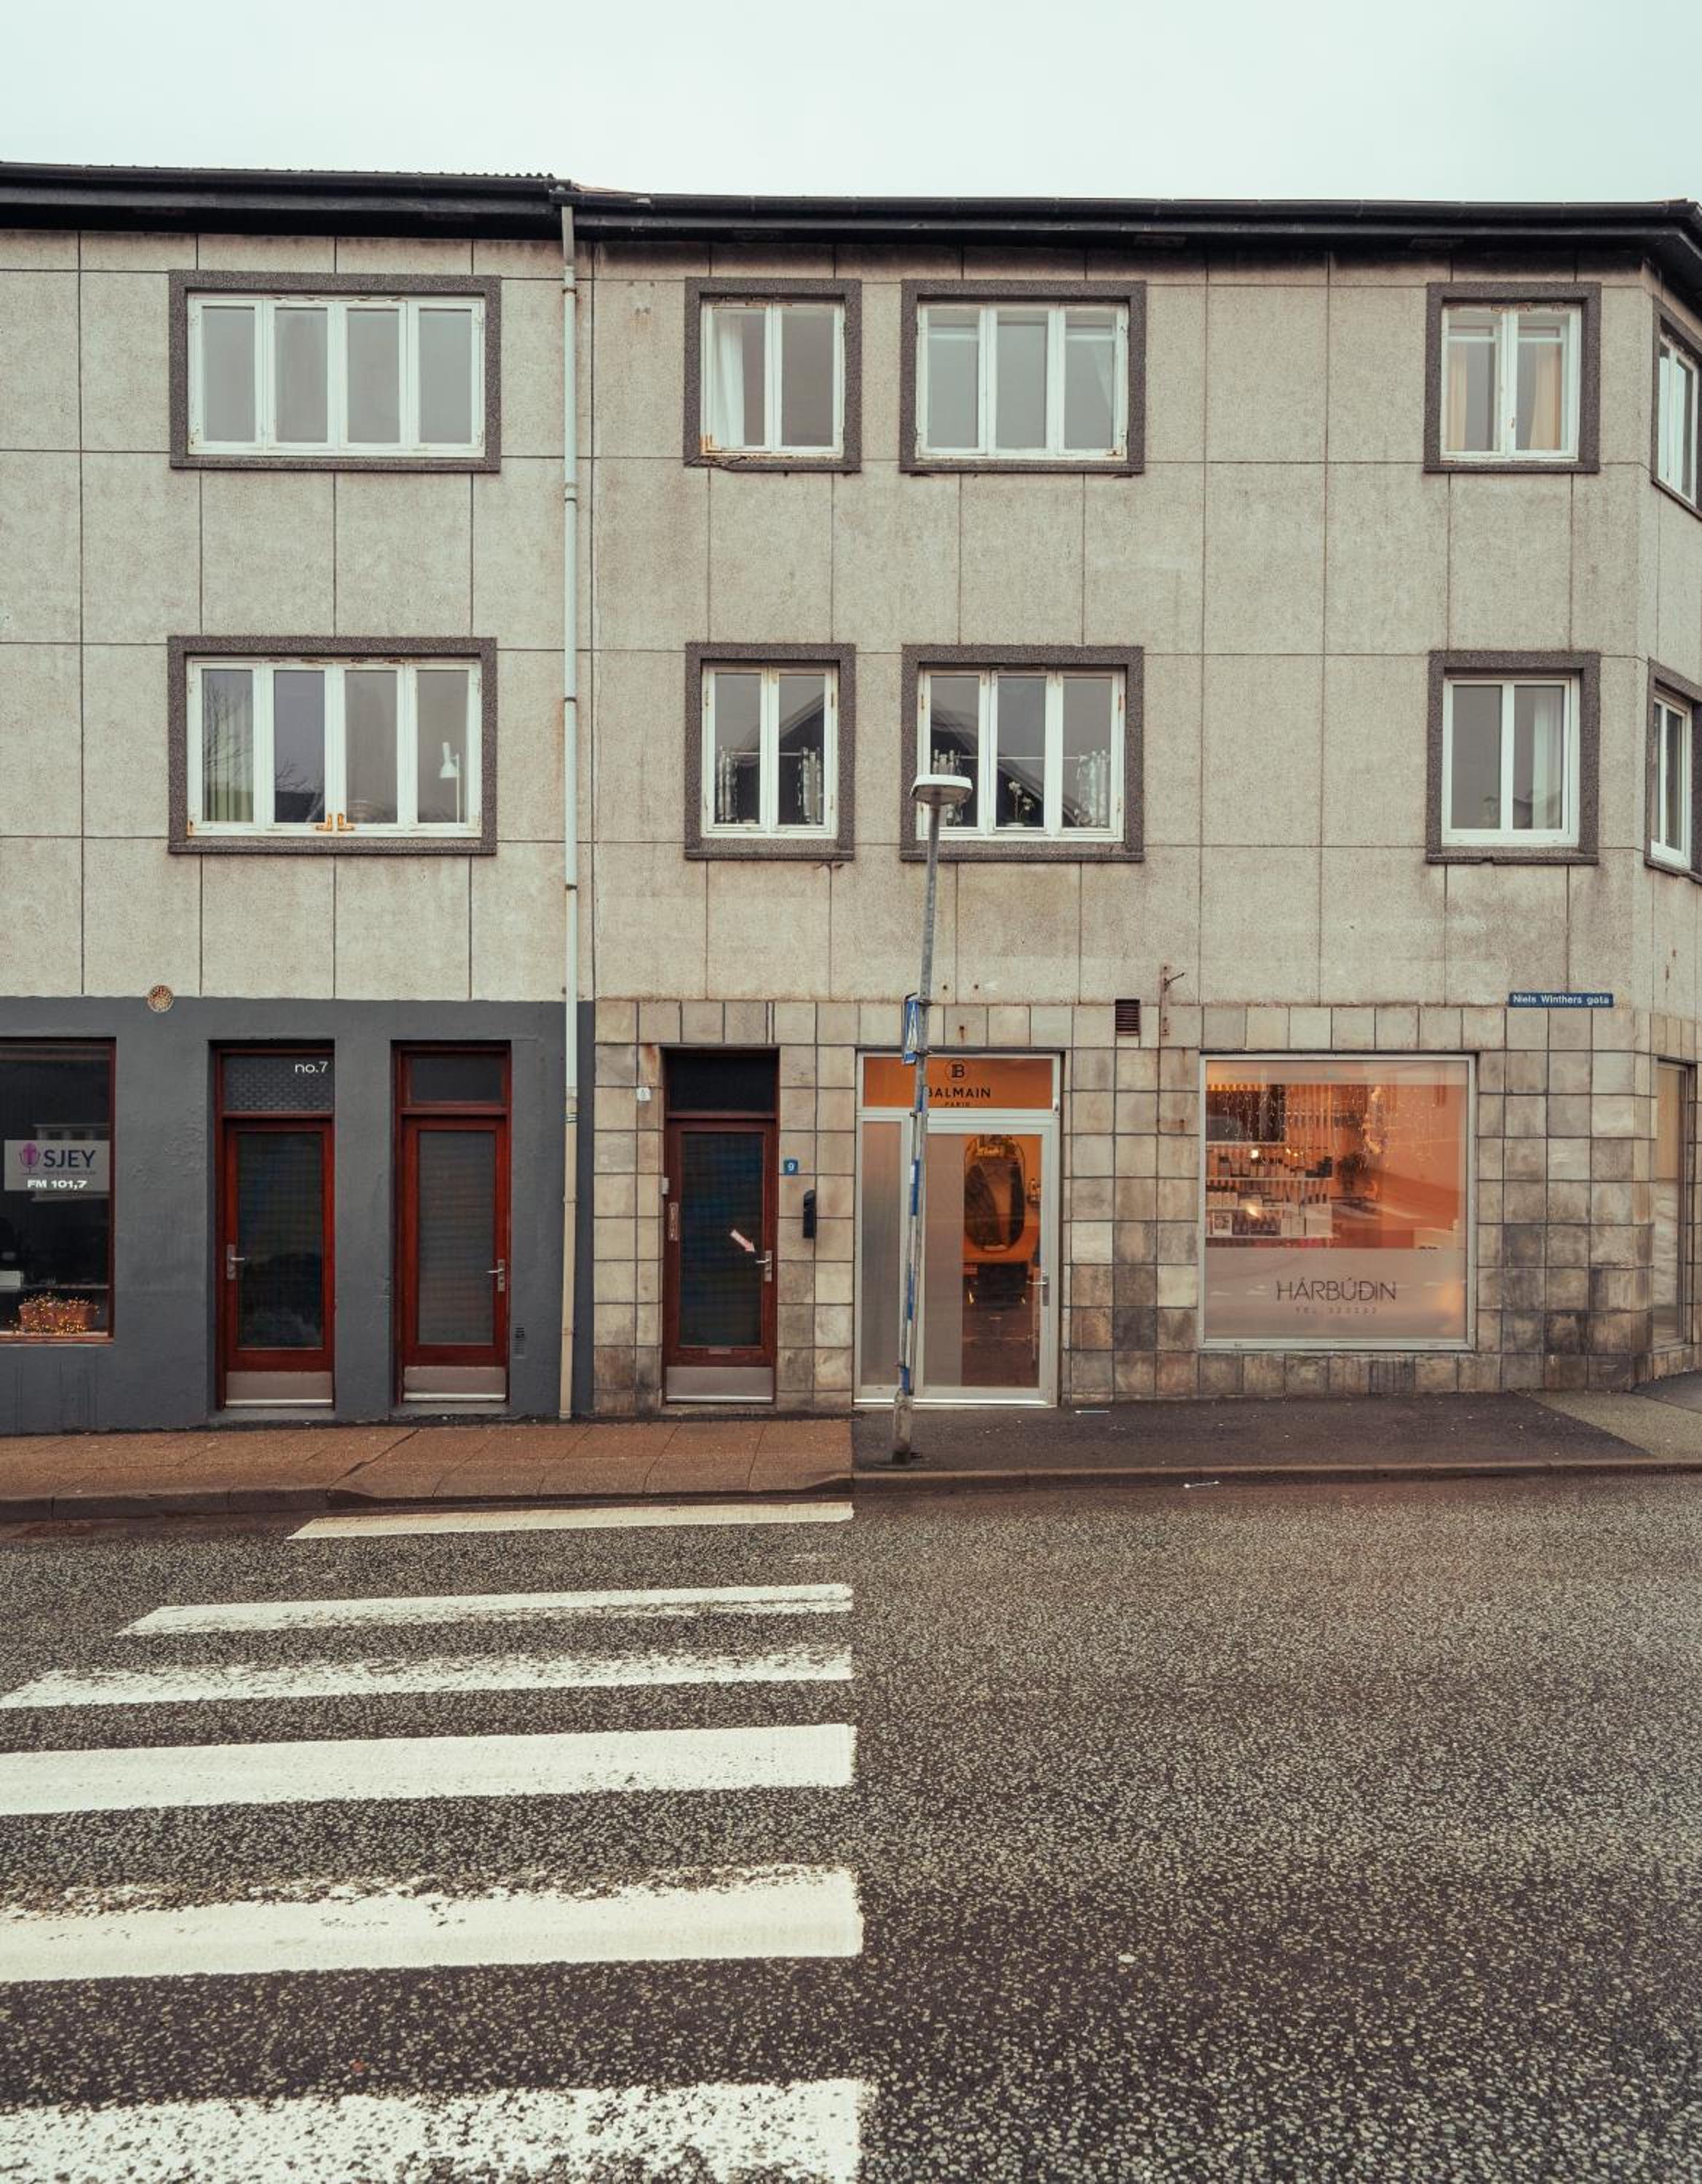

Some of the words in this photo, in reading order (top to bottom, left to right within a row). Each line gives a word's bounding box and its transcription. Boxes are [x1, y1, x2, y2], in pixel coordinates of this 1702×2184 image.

[1513, 994, 1537, 1002] Niels
[1541, 994, 1583, 1004] Winthers
[295, 1061, 328, 1073] no.7
[43, 1150, 96, 1168] SJEY
[788, 1162, 795, 1171] 9
[27, 1179, 47, 1189] FM
[50, 1179, 87, 1190] 101,7
[1276, 1276, 1396, 1301] HÁRBÚÐIN
